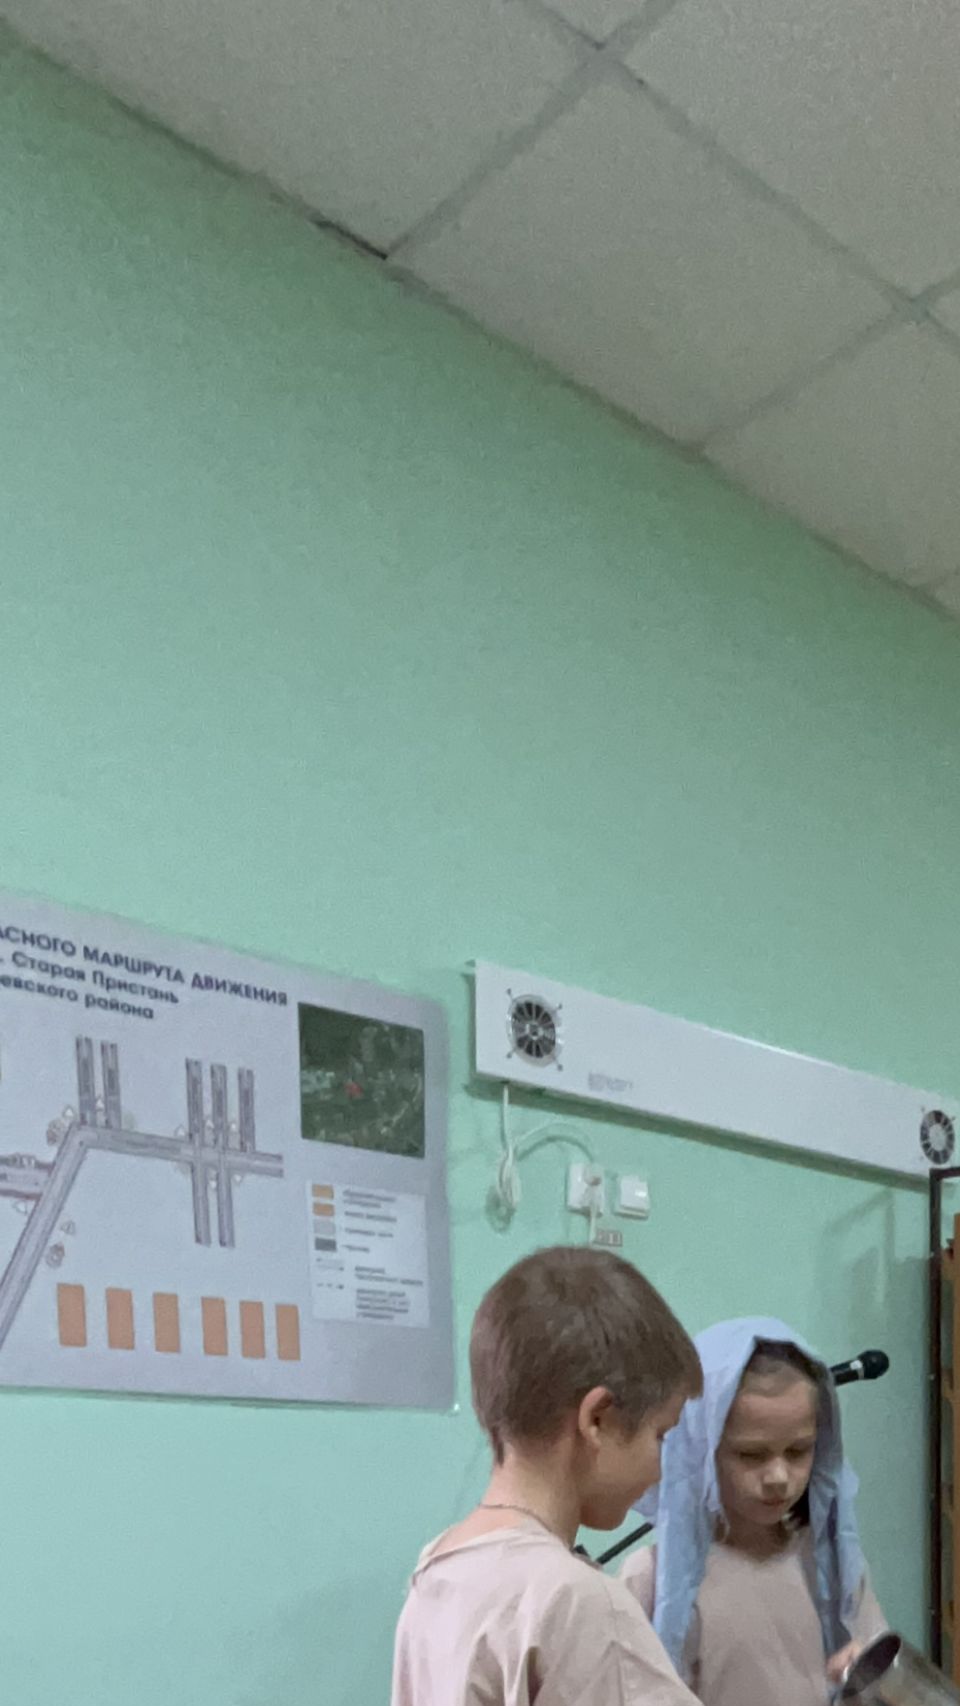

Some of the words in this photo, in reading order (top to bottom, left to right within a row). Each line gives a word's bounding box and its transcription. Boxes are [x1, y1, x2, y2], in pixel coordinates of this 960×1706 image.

[12, 951, 86, 981] Старая
[92, 969, 179, 1004] Пристань
[83, 944, 185, 984] МАРШРУТА
[191, 972, 288, 1006] ДВИЖЕНИЯ
[84, 993, 154, 1019] района
